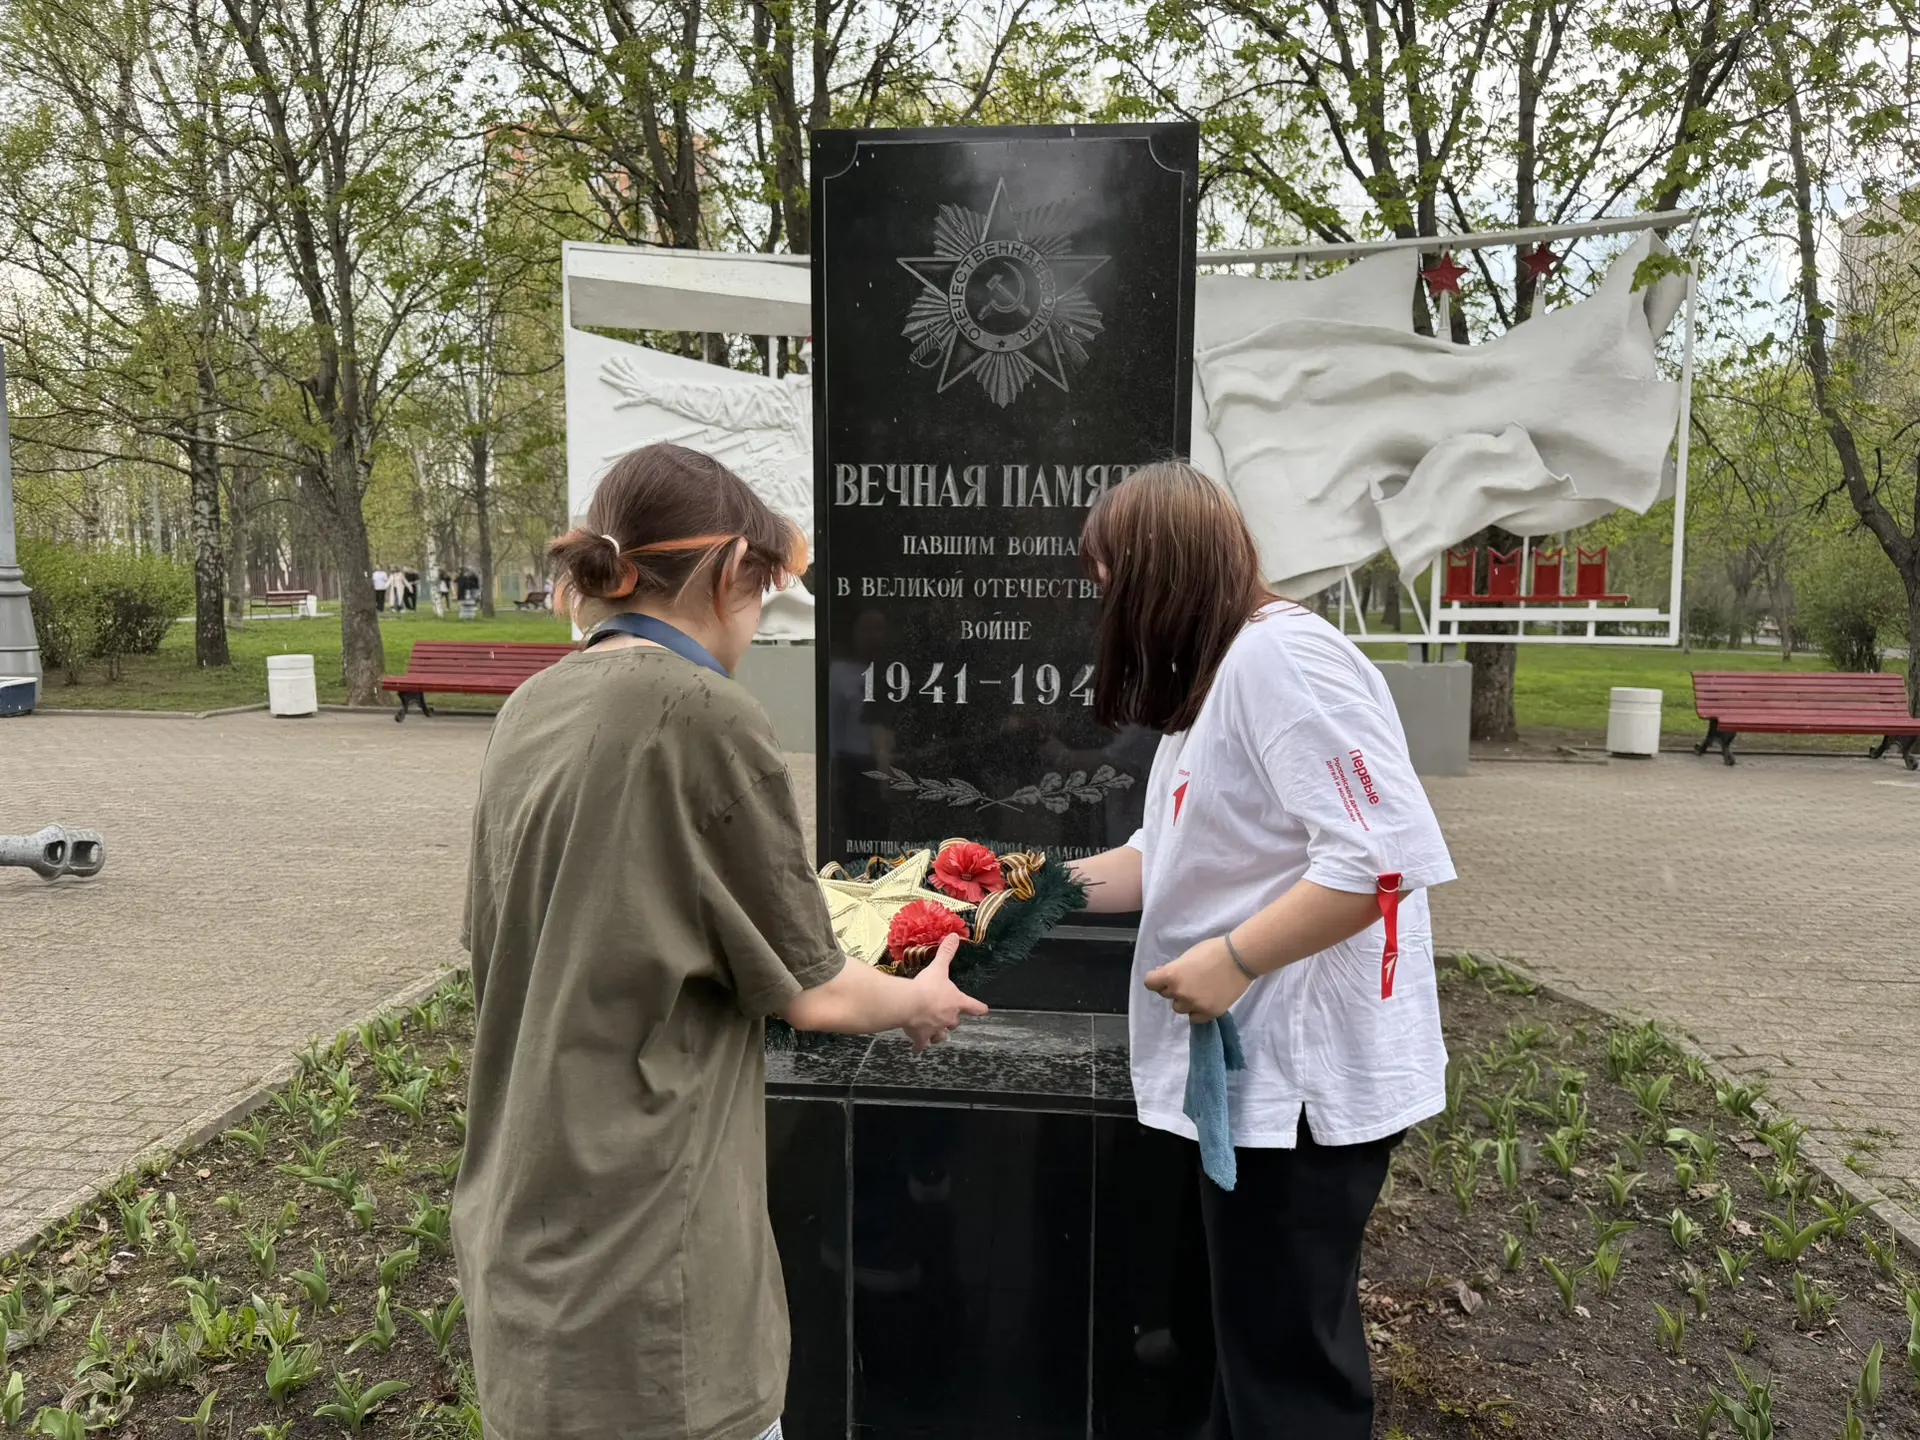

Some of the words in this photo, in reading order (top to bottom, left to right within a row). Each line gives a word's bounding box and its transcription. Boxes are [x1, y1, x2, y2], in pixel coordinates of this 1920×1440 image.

[834, 463, 988, 507] ВЕЧНАЯ
[1002, 463, 1138, 508] ПАМЯТ
[903, 535, 995, 555] ПАВШИМ
[1007, 536, 1081, 557] ВОИНА
[837, 578, 850, 597] В
[862, 570, 964, 598] ВЕЛИКОЙ
[974, 578, 1104, 599] ОТЕЧЕСТВЕ
[960, 611, 1032, 640] ВОЙНЕ
[861, 661, 1095, 706] 1941-194
[1349, 749, 1379, 804] Первые
